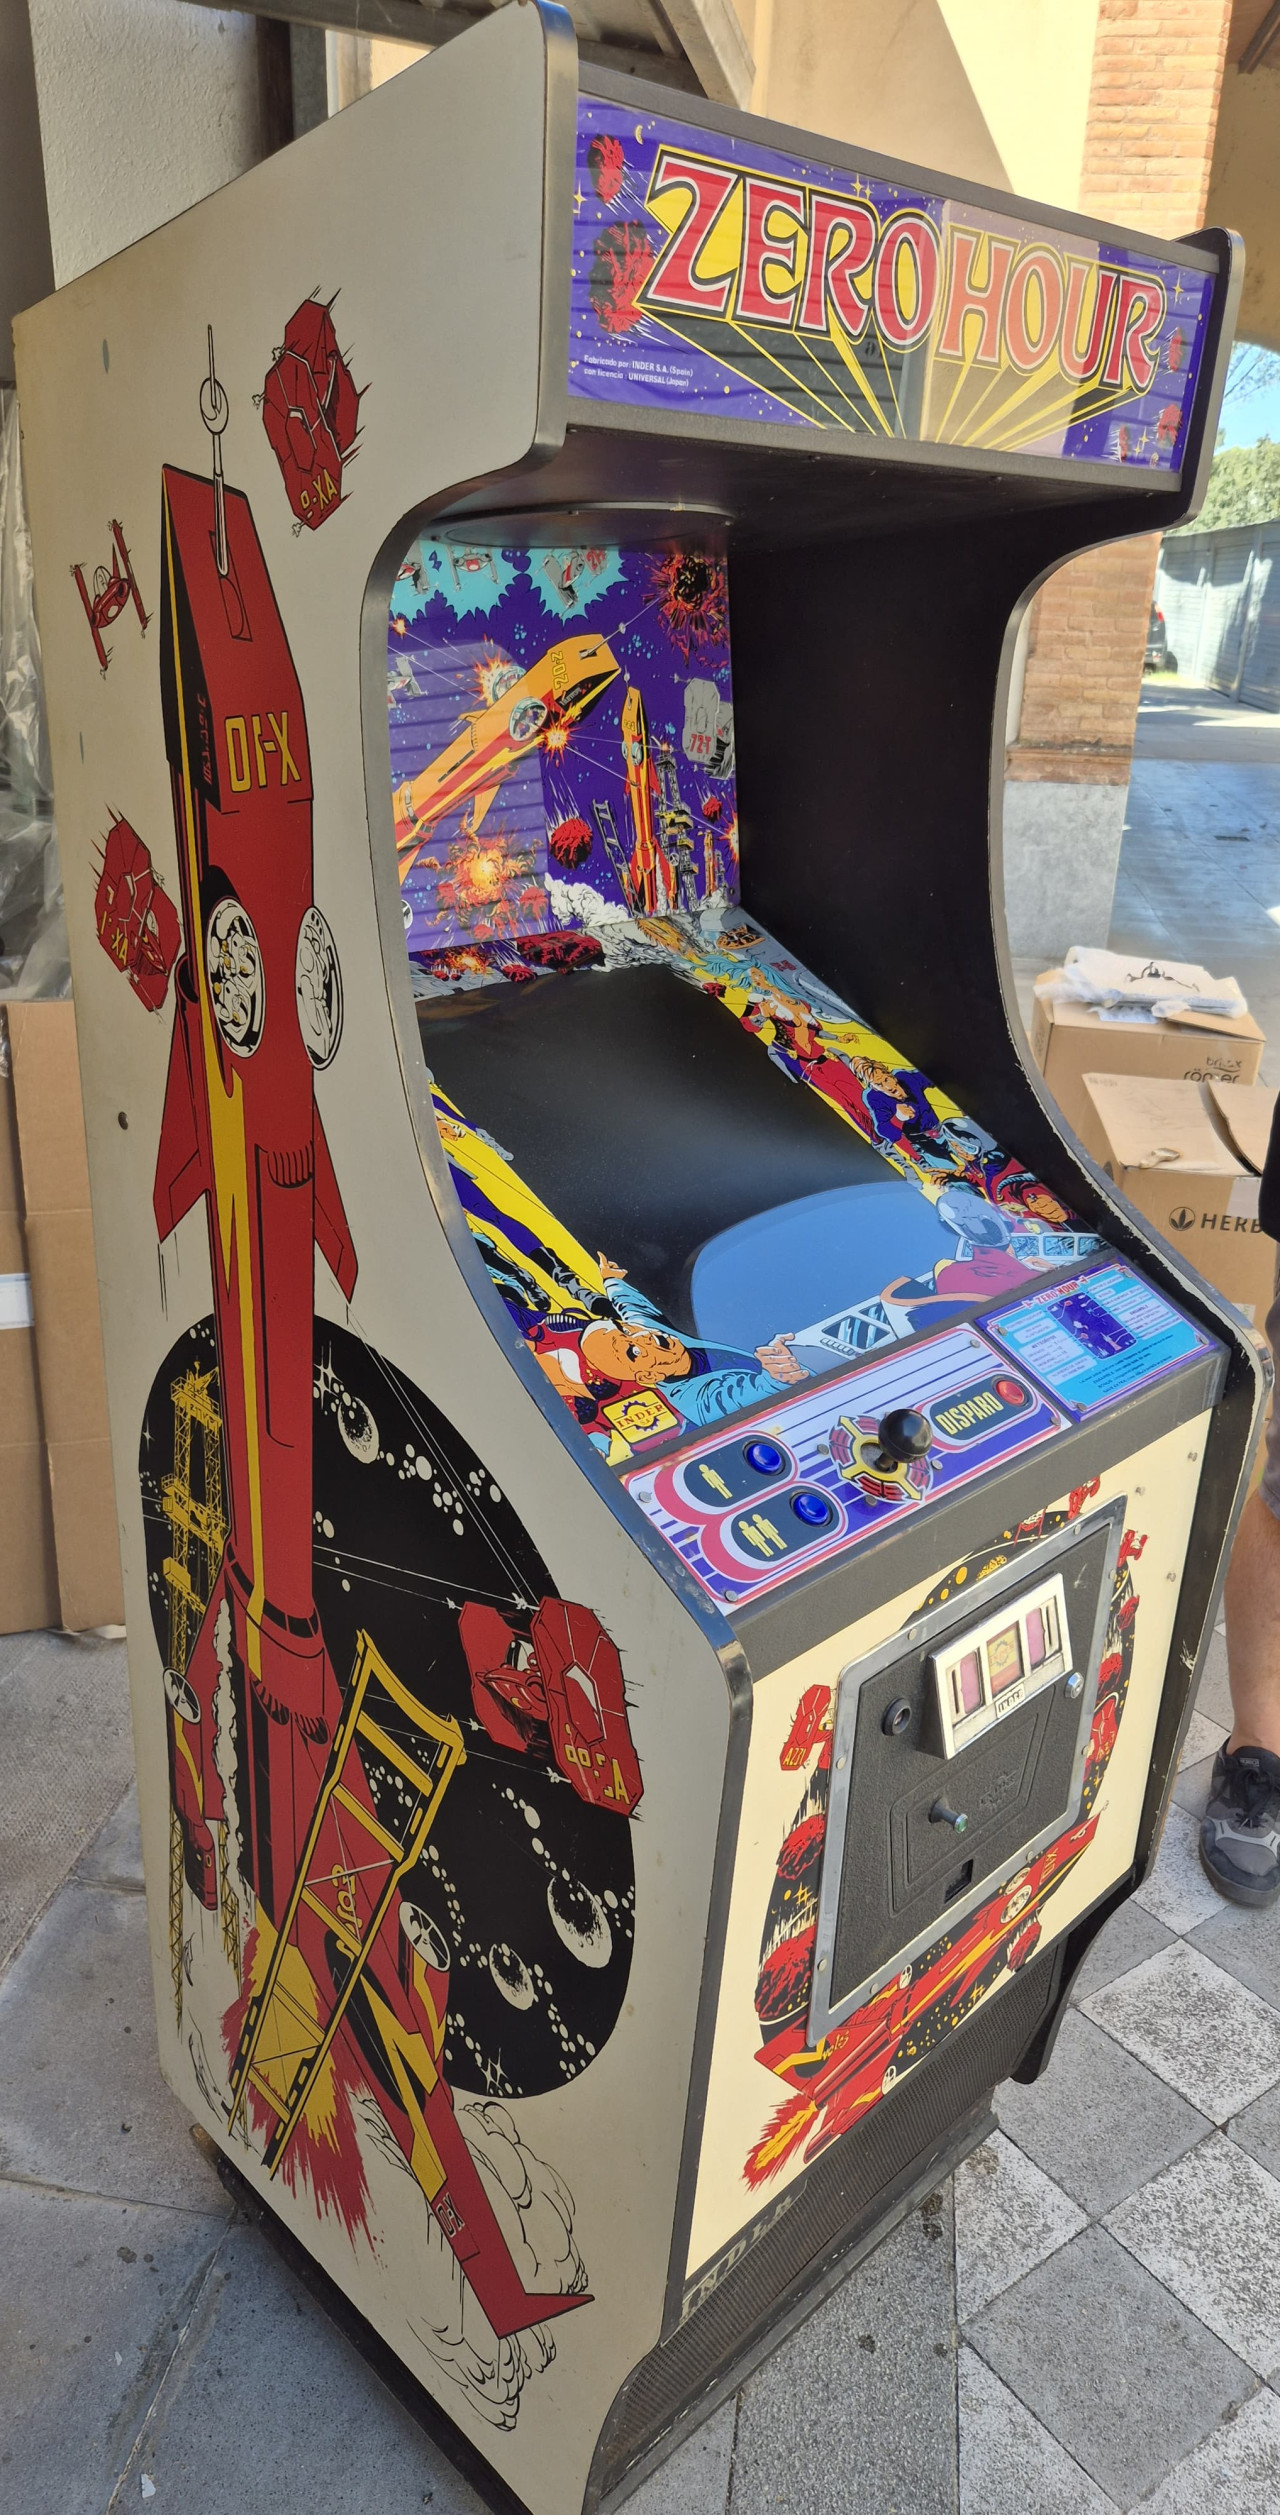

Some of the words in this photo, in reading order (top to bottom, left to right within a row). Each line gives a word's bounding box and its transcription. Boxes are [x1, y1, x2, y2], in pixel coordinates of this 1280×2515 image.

[643, 152, 940, 346] ZERO
[940, 227, 1164, 392] HOUR
[584, 354, 617, 367] Fabricado
[632, 360, 655, 371] INDER
[669, 365, 694, 377] (Spain)
[584, 368, 596, 376] con
[628, 372, 666, 384] UNIVERSAL
[666, 375, 689, 387] (Japan)
[1035, 1290, 1059, 1305] ZERO
[1057, 1280, 1080, 1296] HOUR
[616, 1403, 664, 1428] INDER
[935, 1391, 1004, 1435] DISPARO
